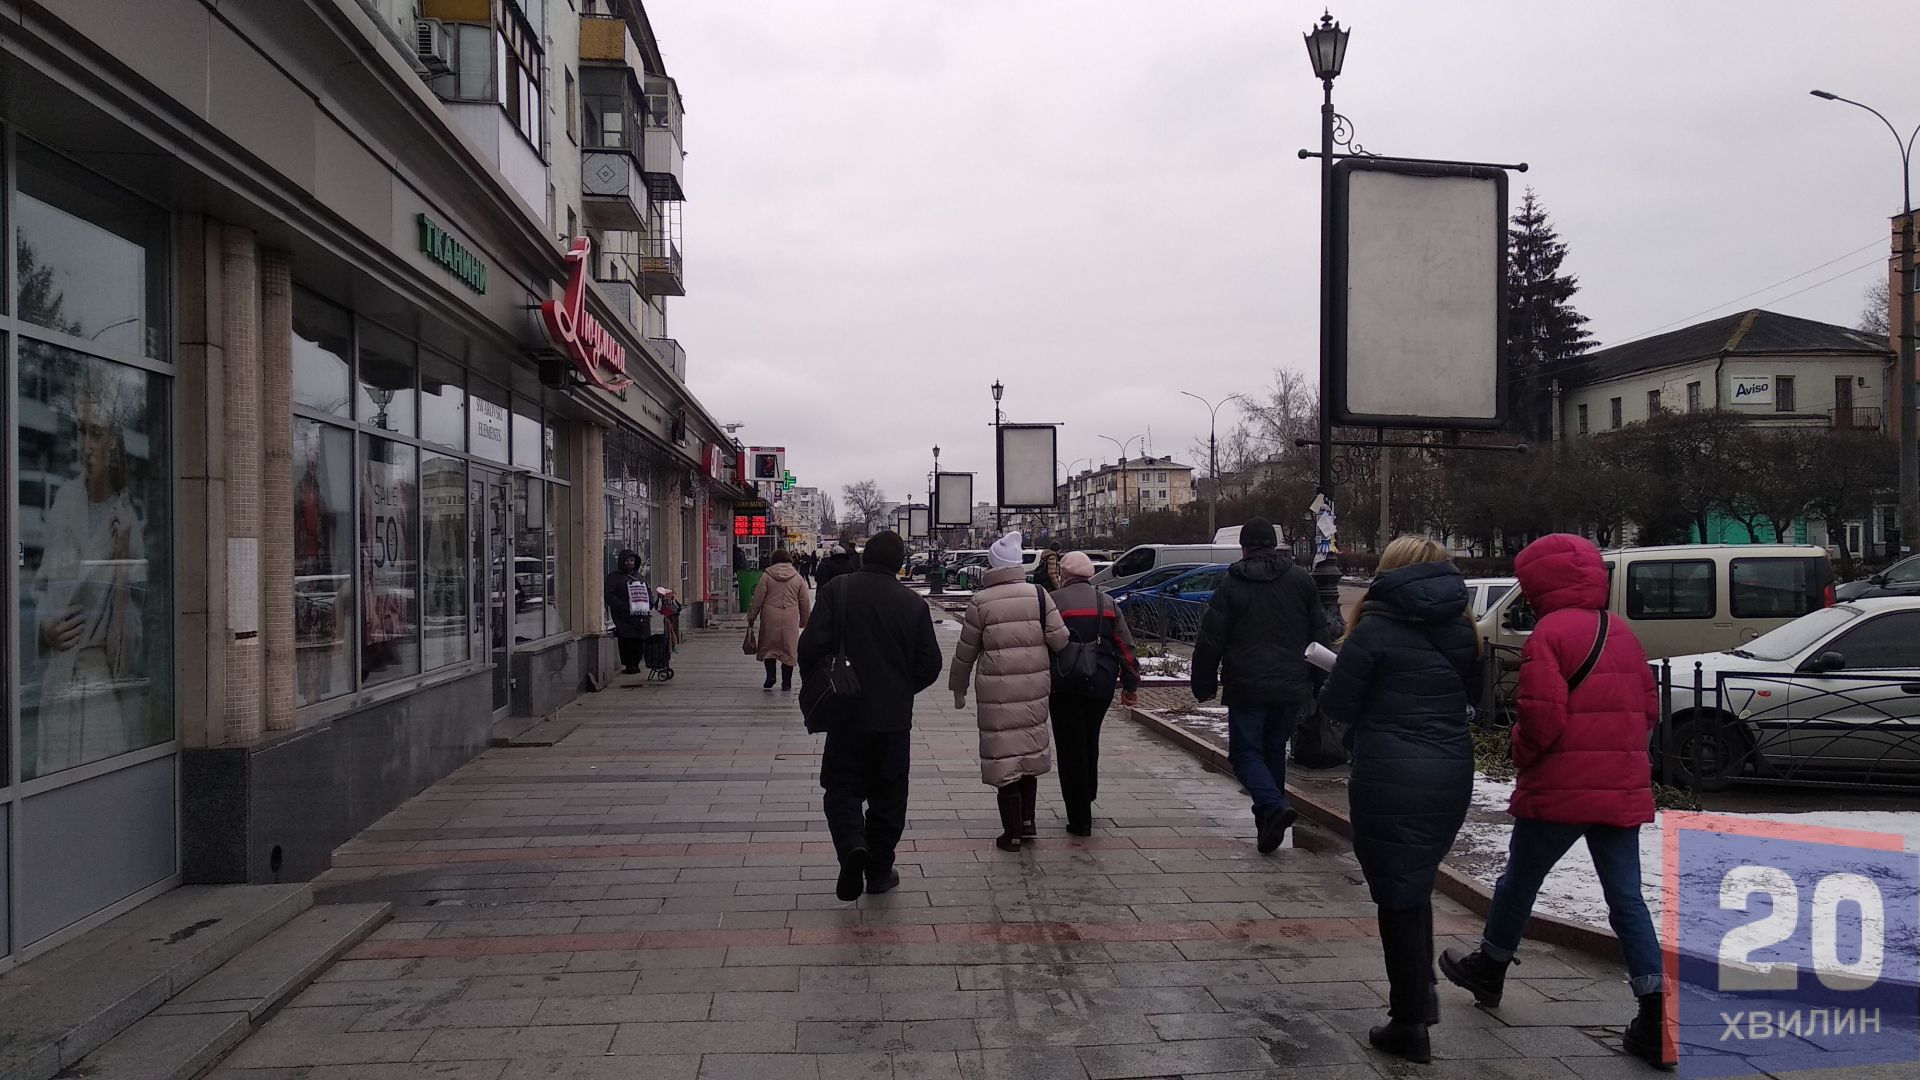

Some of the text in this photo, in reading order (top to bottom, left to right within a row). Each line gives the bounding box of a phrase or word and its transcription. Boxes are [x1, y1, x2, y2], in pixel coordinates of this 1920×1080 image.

[418, 213, 488, 294] ТКАНИНИ
[1736, 383, 1768, 397] Aviso
[478, 421, 502, 442] ELEMENTS
[374, 483, 398, 507] SALE
